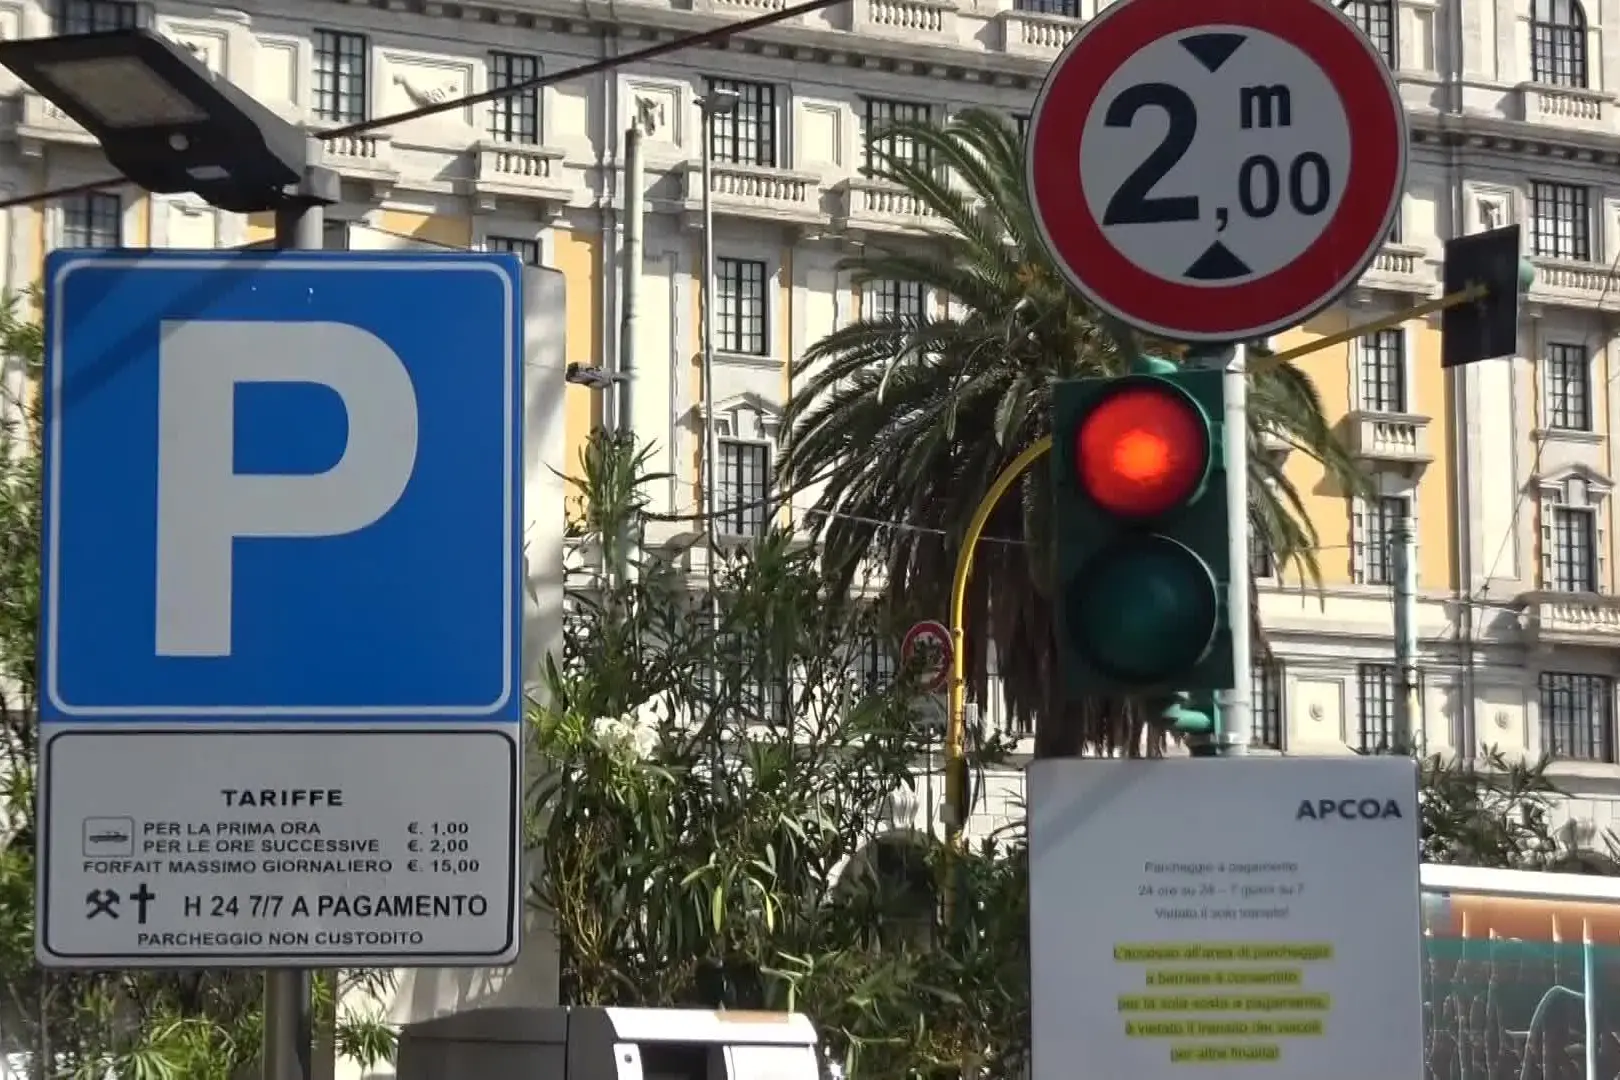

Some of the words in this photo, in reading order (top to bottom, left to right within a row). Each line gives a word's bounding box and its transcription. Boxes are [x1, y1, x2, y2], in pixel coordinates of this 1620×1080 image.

[1239, 84, 1291, 129] m
[155, 319, 418, 656] P
[221, 789, 343, 807] TARIFFE
[1296, 798, 1402, 819] APCOA
[143, 821, 181, 836] PER
[187, 821, 211, 836] LA
[216, 821, 275, 836] PRIMA
[280, 821, 321, 835] ORA
[143, 839, 181, 853] PER
[187, 839, 211, 853] LE
[216, 839, 256, 853] ORE
[261, 838, 380, 853] SUCCESSIVE
[83, 860, 162, 874] FORFAIT
[168, 860, 257, 874] MASSIMO
[262, 859, 393, 874] GIORNALIERO
[184, 895, 201, 917] H
[210, 895, 239, 918] 24
[249, 895, 284, 918] 7/7
[291, 895, 310, 917] A
[317, 894, 488, 918] PAGAMENTO
[137, 932, 263, 946] PARCHEGGIO
[268, 932, 309, 946] NON
[314, 931, 424, 946] CUSTODITO
